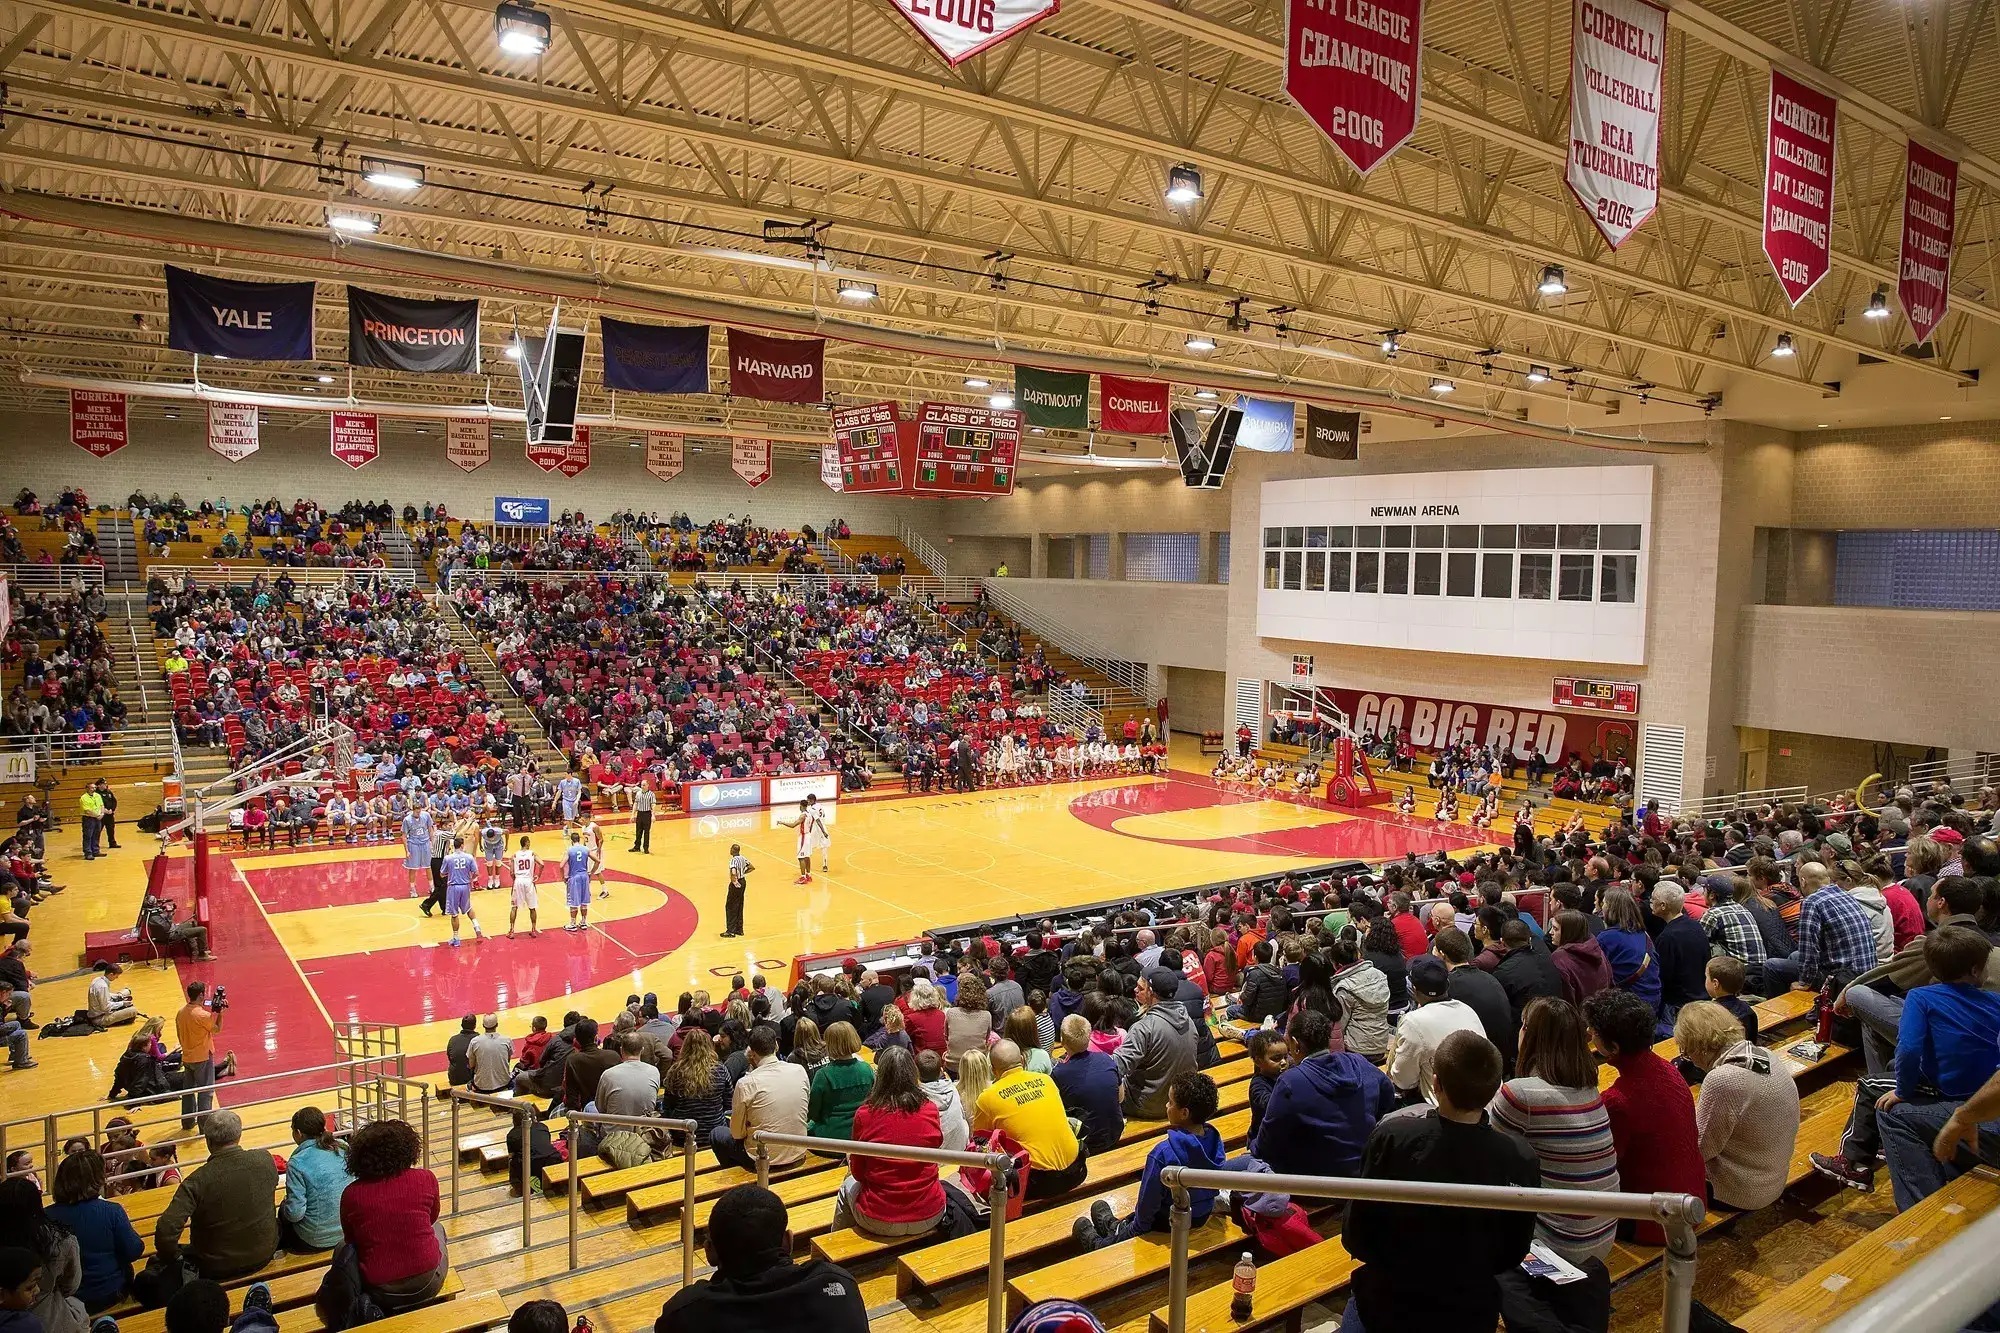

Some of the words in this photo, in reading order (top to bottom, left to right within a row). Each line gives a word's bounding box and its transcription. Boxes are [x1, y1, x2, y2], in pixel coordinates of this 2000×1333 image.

[1345, 0, 1410, 44] LEAGUE
[1581, 1, 1658, 64] CORNELL
[1300, 28, 1410, 102] CHAMPIONS
[1585, 64, 1656, 113] VOLLEYBALL
[1333, 106, 1384, 148] 2006
[1774, 94, 1830, 144] CORNELL
[1600, 120, 1633, 155] NCAA
[1572, 139, 1655, 190] TOURNAMENT
[1774, 136, 1828, 177] VOLLEYBALL
[1772, 172, 1790, 196] IVY
[1792, 179, 1825, 209] LEAGUE
[1597, 198, 1633, 229] 2005
[1771, 205, 1826, 250] CHAMPIONS
[1782, 258, 1809, 285] 2005
[212, 307, 272, 330] YALE
[1912, 303, 1932, 326] 2004
[364, 318, 465, 346] PRINCETON
[737, 356, 814, 380] HARVARD
[75, 390, 122, 402] CORNELL
[1024, 388, 1082, 408] DARTMOUTH
[844, 408, 870, 416] PRESENTED
[944, 405, 990, 416] PRESENTED
[1108, 396, 1162, 414] CORNELL
[75, 413, 123, 422] BASKETBALL
[835, 416, 859, 427] CLASS
[861, 414, 871, 424] OF
[872, 411, 891, 422] 1960
[926, 411, 966, 424] CLASS
[970, 415, 986, 424] OF
[990, 417, 1017, 428] 1960
[76, 430, 124, 440] CHAMPIONS
[335, 427, 375, 435] BASKETBALL
[924, 425, 944, 434] CORNELL
[995, 431, 1016, 440] VISITOR
[1316, 427, 1350, 442] BROWN
[210, 436, 257, 445] TOURNAMENT
[962, 430, 990, 447] 1:56
[336, 442, 375, 453] CHAMPIONS
[449, 448, 487, 456] TOURNAMENT
[529, 446, 565, 456] CHAMPIONS
[929, 470, 936, 481] 8
[1001, 474, 1007, 486] 9
[1370, 506, 1416, 517] NEWMAN
[1421, 505, 1460, 516] ARENA
[1587, 684, 1611, 697] 1:56
[1354, 694, 1404, 741] GO
[1411, 700, 1478, 748] BIG
[1486, 708, 1567, 764] RED
[720, 786, 752, 800] pepsi
[454, 858, 466, 869] 32
[576, 851, 582, 862] 2
[518, 860, 530, 870] 20
[998, 1083, 1027, 1099] CORNELL
[1025, 1078, 1045, 1089] POLICE
[1015, 1090, 1044, 1106] AUXILIARY
